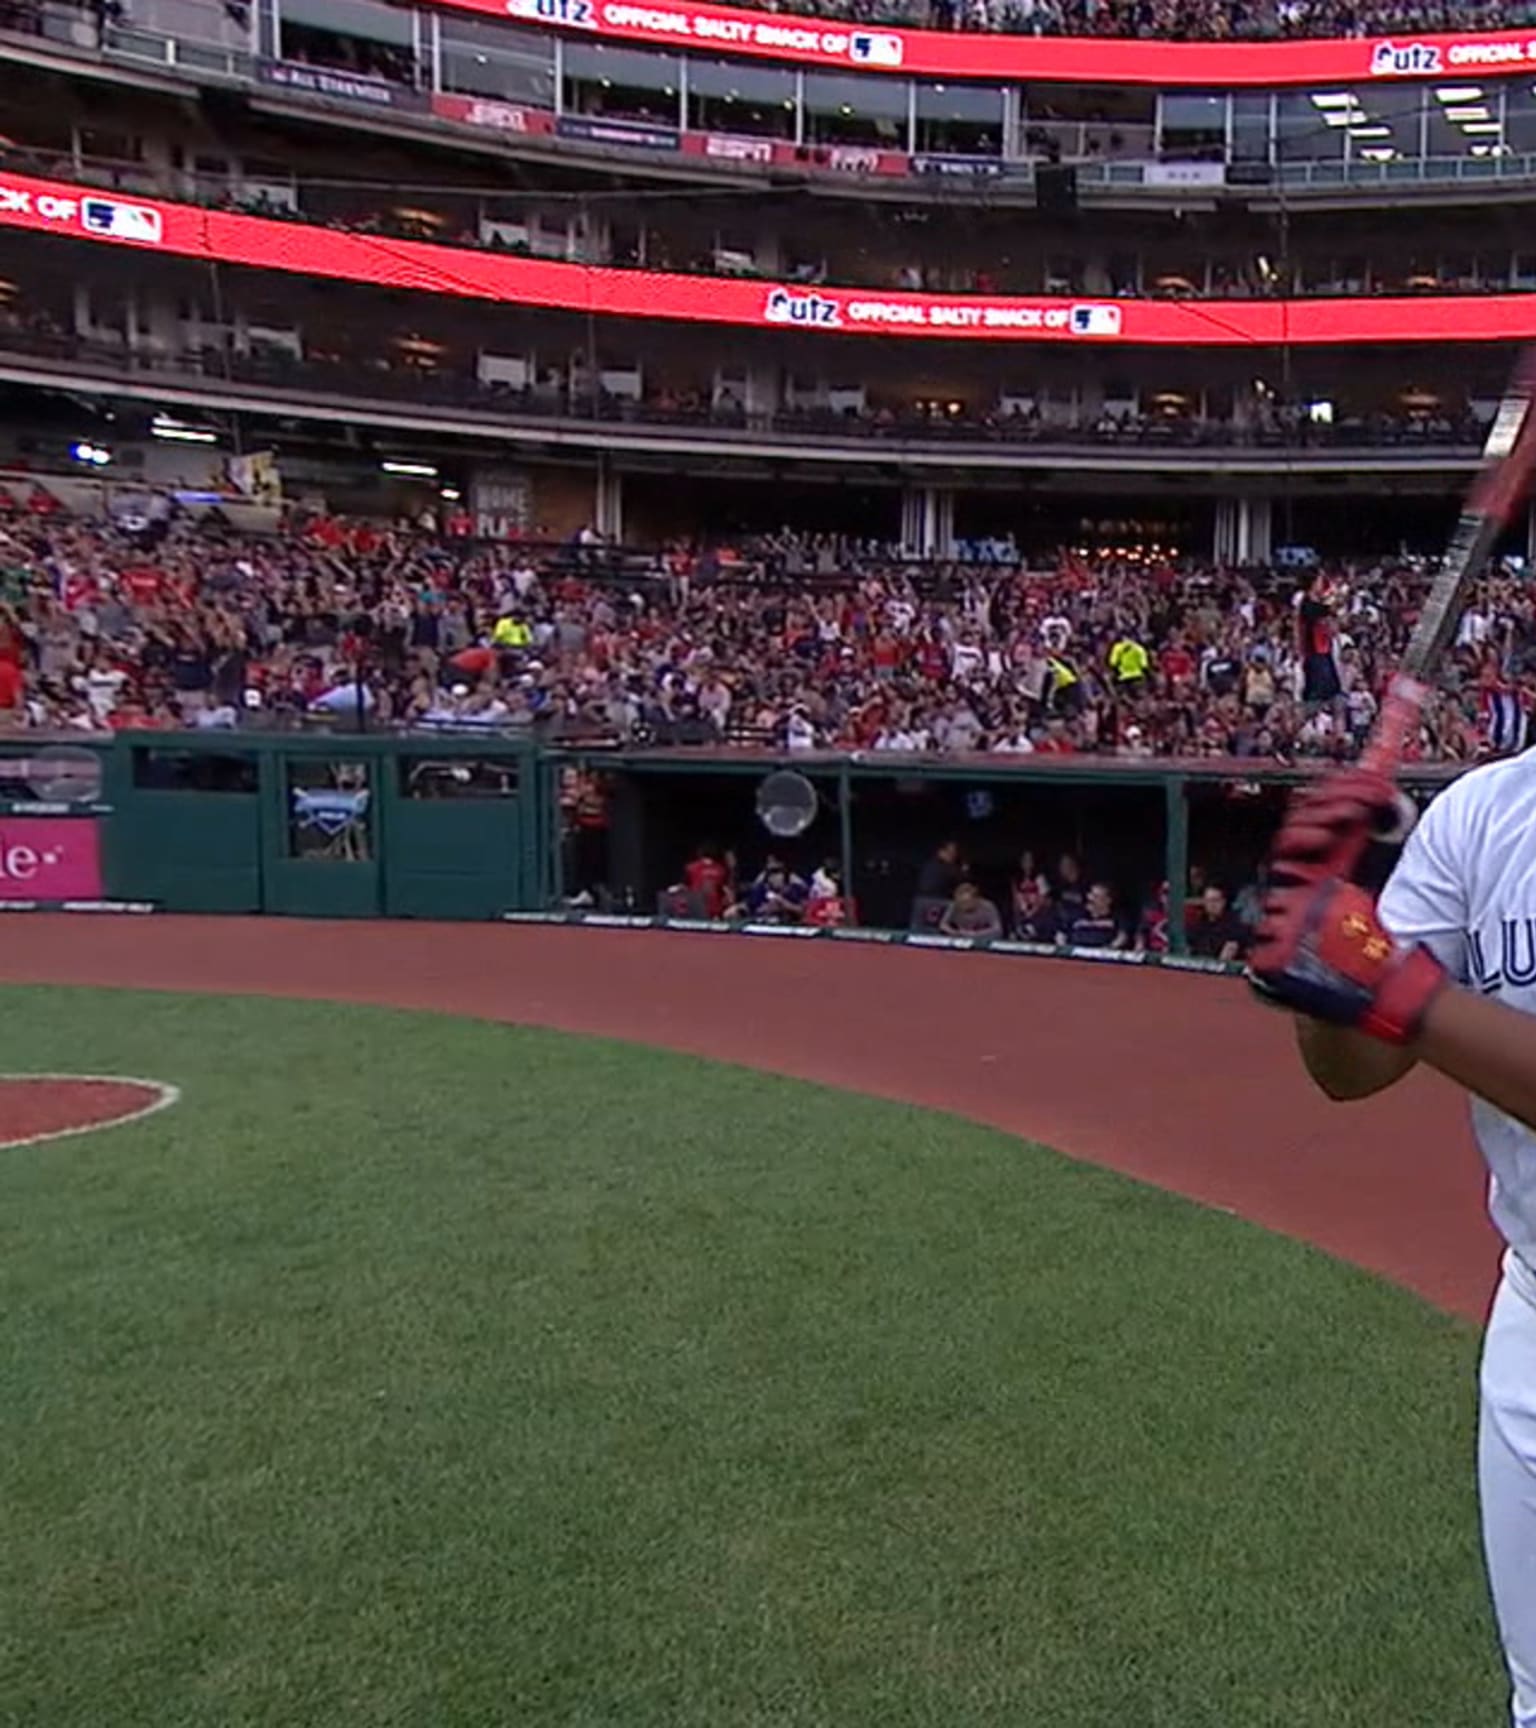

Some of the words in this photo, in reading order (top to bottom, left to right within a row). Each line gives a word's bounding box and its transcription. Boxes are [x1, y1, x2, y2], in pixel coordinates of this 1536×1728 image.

[604, 6, 691, 35] OFFICIAL
[694, 18, 753, 42] SALTY
[756, 25, 818, 49] SNACK
[821, 33, 848, 54] OF
[1449, 44, 1524, 65] OFFICIAL
[706, 137, 771, 162] ESPN
[37, 195, 78, 221] OF
[849, 301, 926, 325] OFFICIAL
[930, 304, 981, 326] SALTY
[984, 307, 1044, 327] SNACK
[1045, 309, 1069, 329] OF
